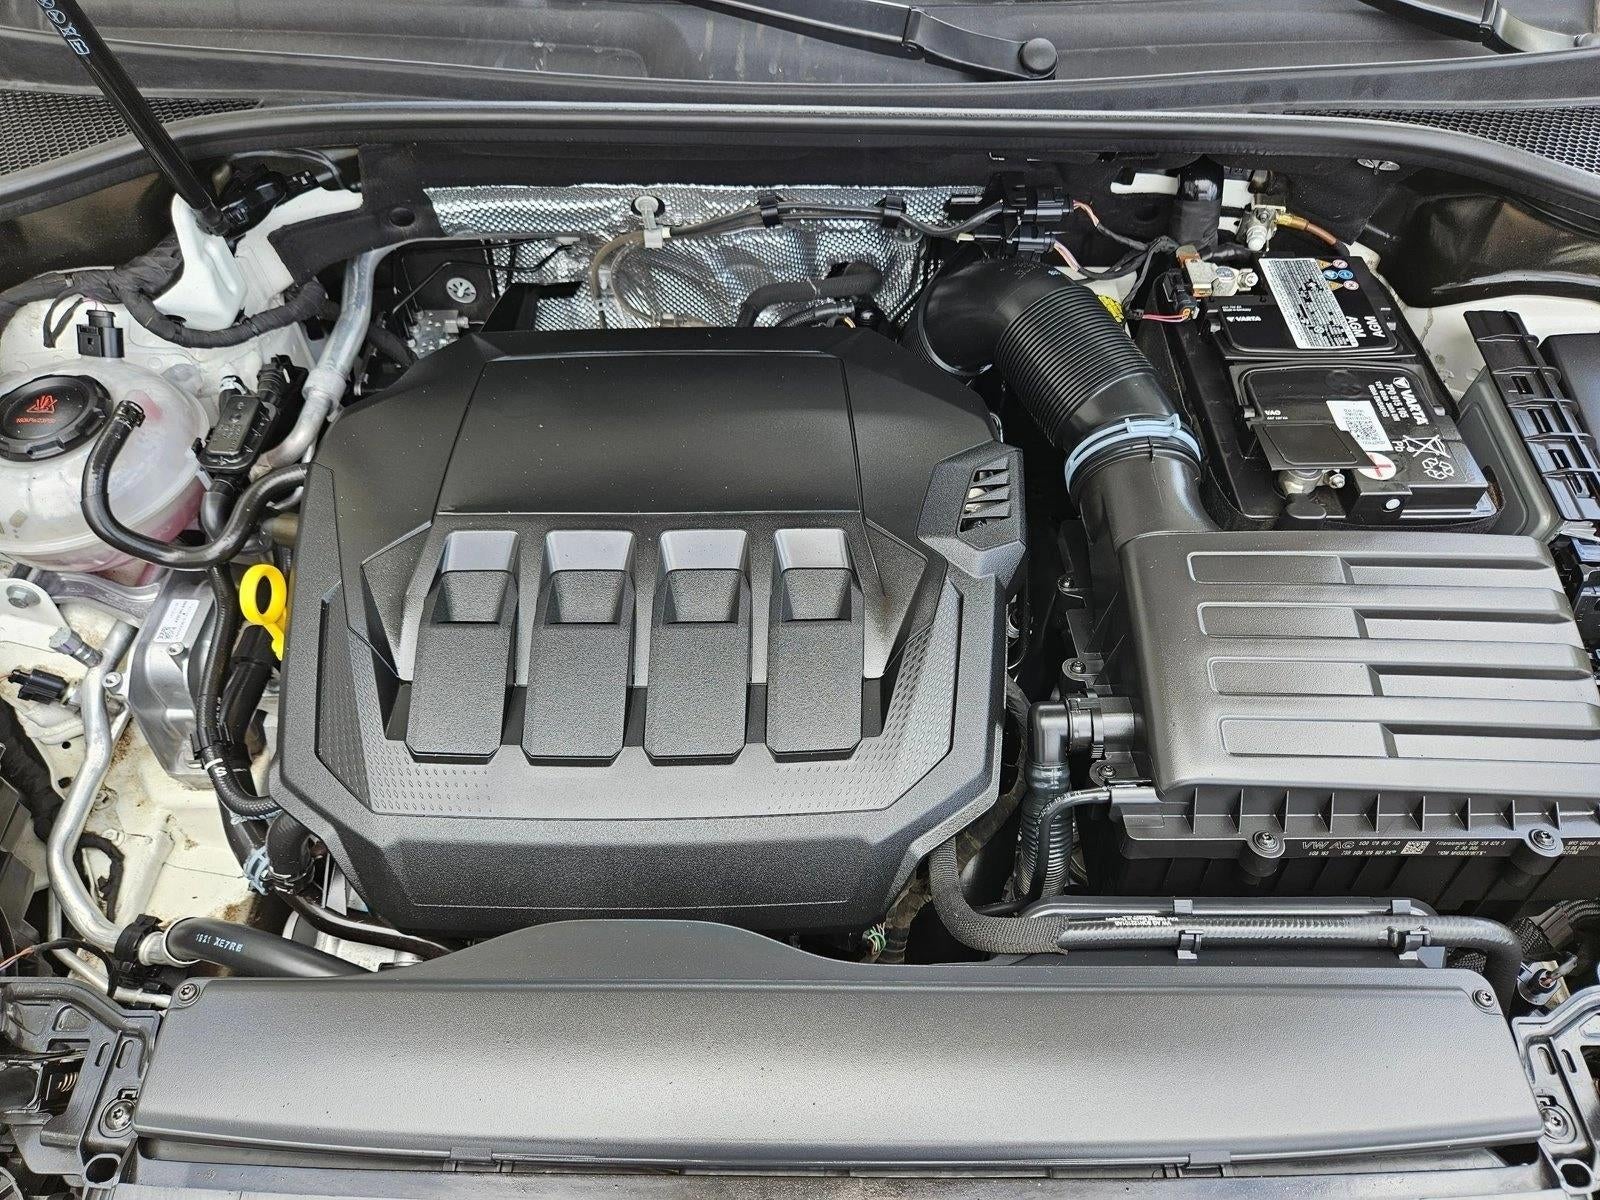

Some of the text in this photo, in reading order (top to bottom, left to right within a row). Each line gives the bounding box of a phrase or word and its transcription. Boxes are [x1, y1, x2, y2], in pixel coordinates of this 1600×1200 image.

[1345, 315, 1367, 338] AGM
[1363, 315, 1386, 338] AGM
[1400, 388, 1429, 426] VARTA
[1391, 440, 1406, 453] Pb
[1302, 841, 1330, 850] VW
[1329, 841, 1355, 850] AG
